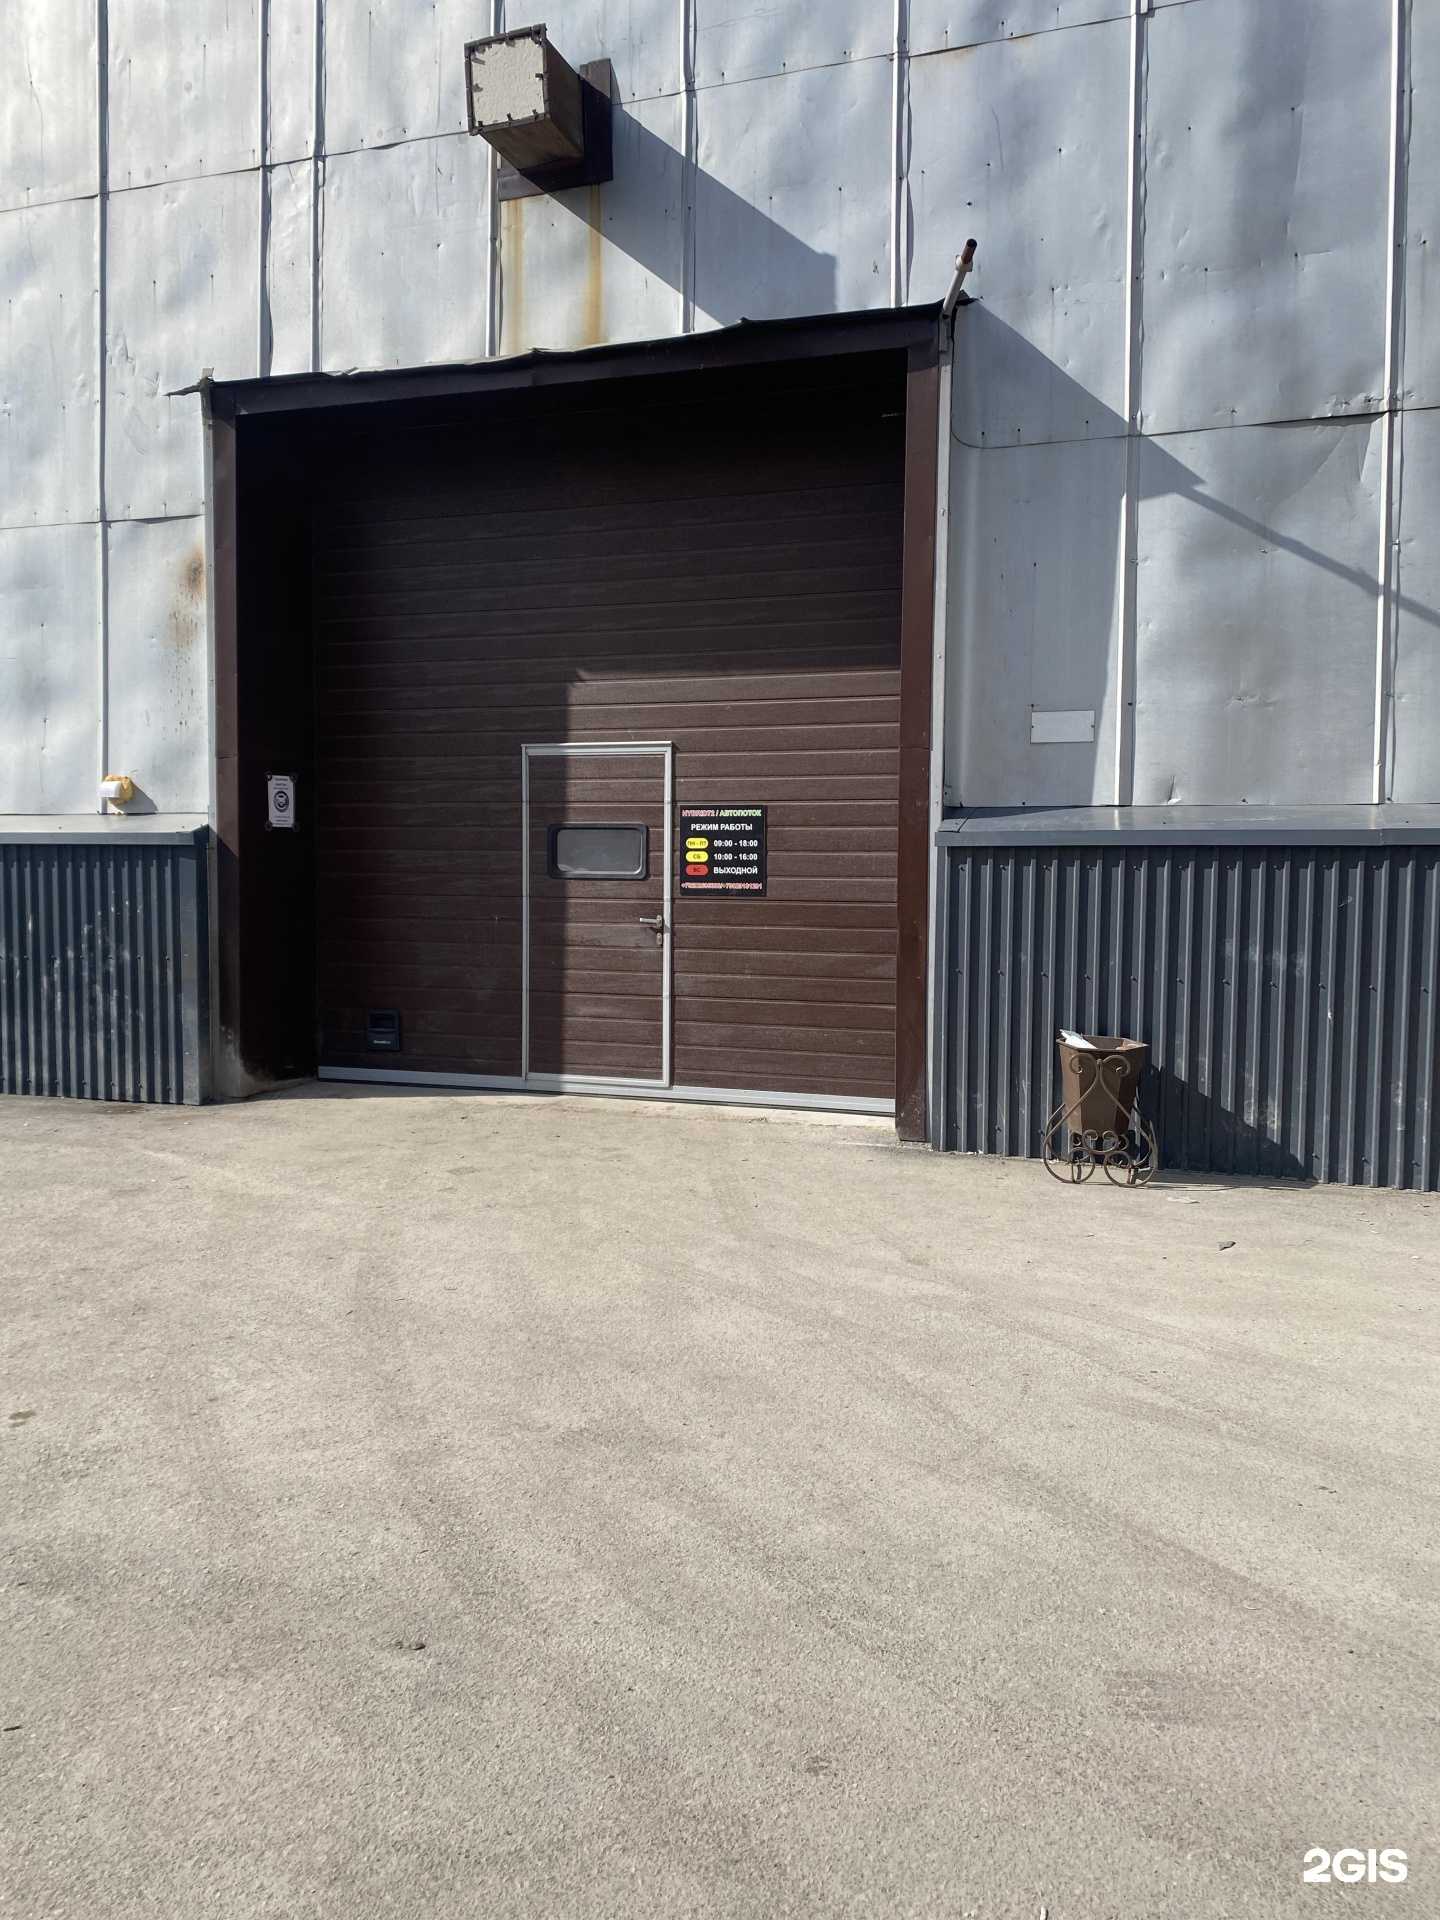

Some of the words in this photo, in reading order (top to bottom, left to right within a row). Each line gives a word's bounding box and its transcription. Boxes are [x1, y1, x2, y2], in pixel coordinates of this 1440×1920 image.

[719, 809, 762, 817] АВТОПОТОК
[691, 823, 718, 831] РЕЖИМ
[720, 823, 753, 831] РАБОТЫ
[713, 839, 733, 847] 09:00
[739, 839, 758, 847] 18:00
[713, 853, 733, 861] 10:00
[739, 853, 758, 861] 16:00
[713, 866, 758, 875] ВЫХОДНОЙ
